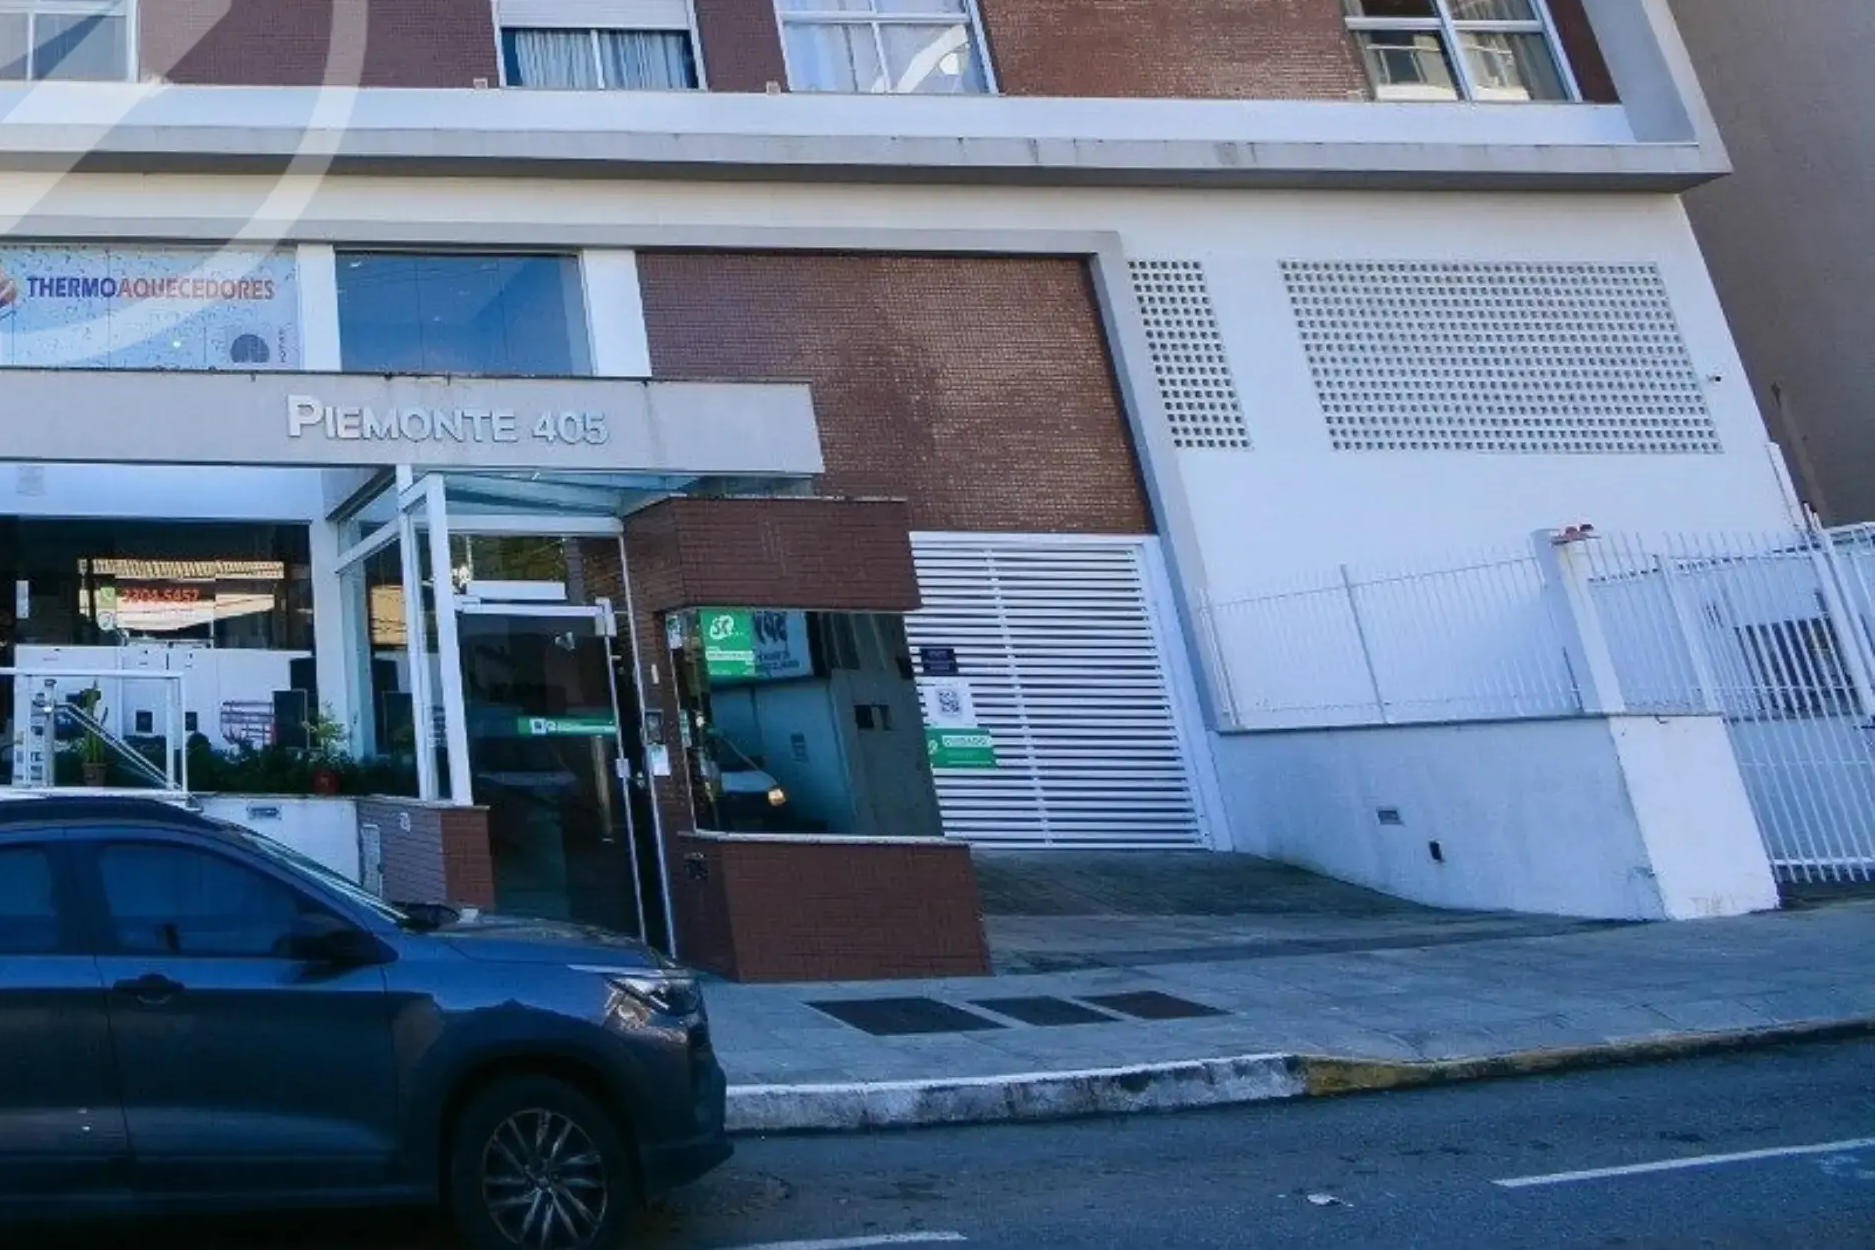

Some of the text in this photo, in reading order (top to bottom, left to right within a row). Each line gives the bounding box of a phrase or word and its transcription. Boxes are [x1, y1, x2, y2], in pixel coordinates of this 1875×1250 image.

[26, 276, 276, 301] THERMOAQUECEDORES
[286, 394, 611, 445] PIEMONTE 405
